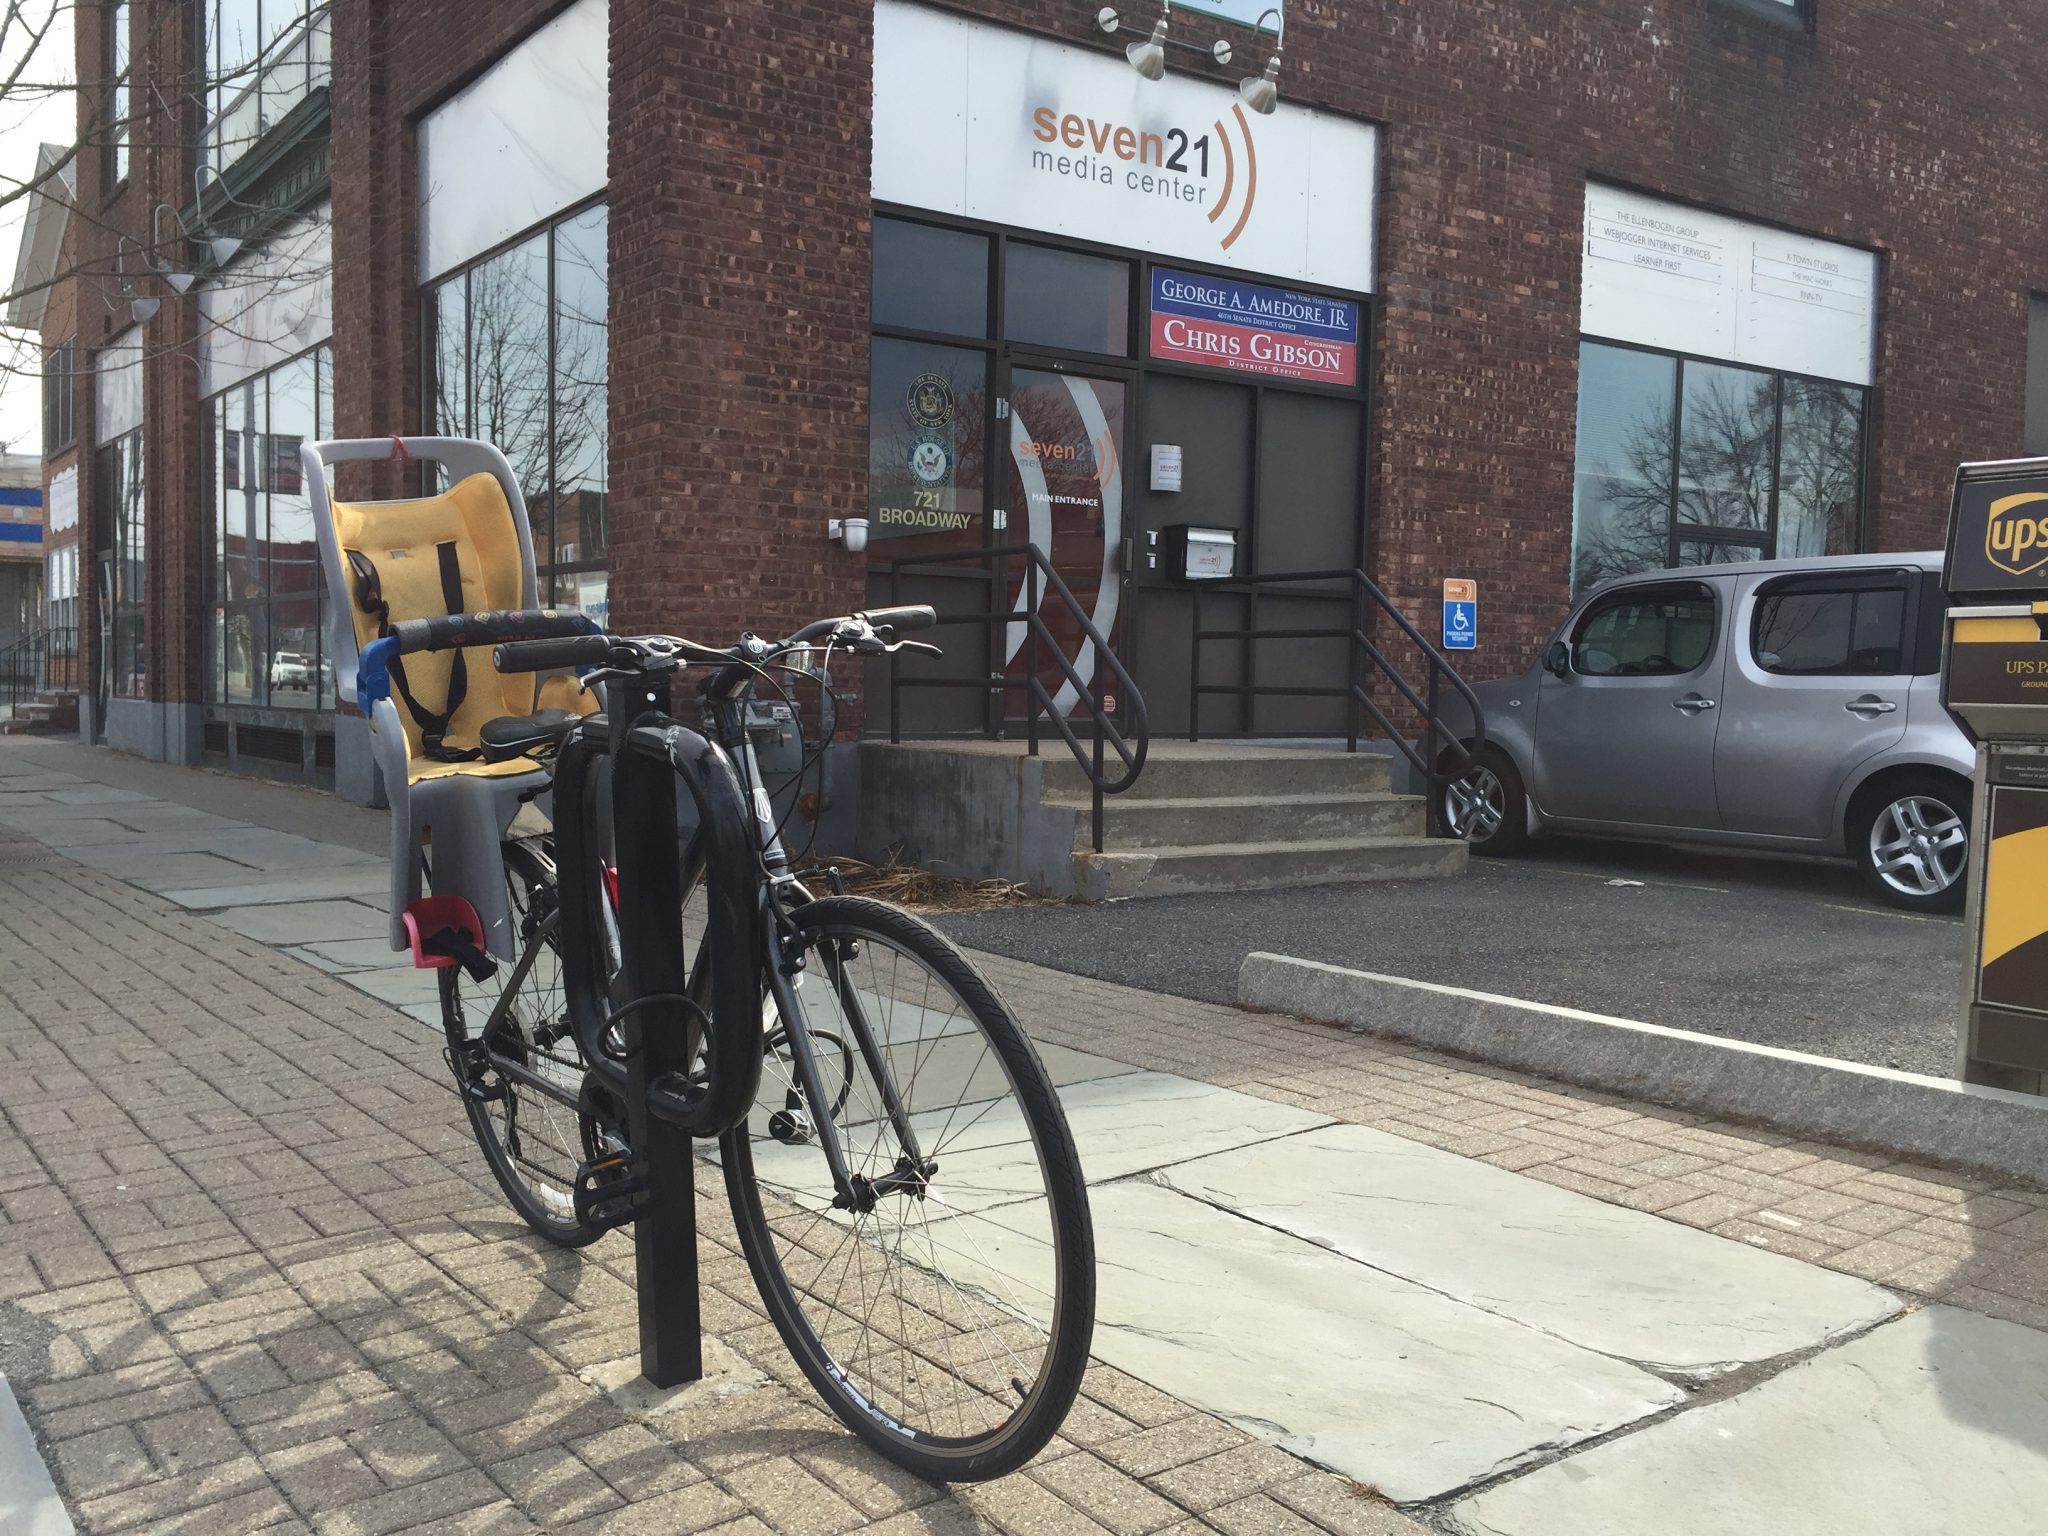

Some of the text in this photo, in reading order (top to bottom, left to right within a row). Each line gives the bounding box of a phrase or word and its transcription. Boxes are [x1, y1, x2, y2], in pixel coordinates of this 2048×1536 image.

[1032, 107, 1209, 178] seven21
[1032, 150, 1207, 204] media center
[1616, 210, 1700, 239] THE ELLENBOGEN GROUP
[1603, 227, 1711, 261] WEBJOGGER INTERNET SERVICES
[1633, 254, 1681, 272] LEARNER FIRST
[1161, 279, 1349, 328] GEORGE A. AMEDORE, JR.
[1298, 295, 1311, 303] YORK
[1312, 297, 1326, 306] STATE
[1326, 300, 1348, 310] SENATOR
[1217, 312, 1296, 331] 46TH SENATE DISTRICT OFFICE
[1163, 319, 1341, 370] CHRIS GIBSON
[1229, 360, 1301, 376] DISTRICT OFFICE
[1019, 441, 1095, 461] seven21
[913, 490, 940, 508] 721
[1031, 492, 1099, 507] MAIN ENTRANCE
[879, 507, 971, 530] BROADWAY
[2006, 661, 2035, 674] UPS
